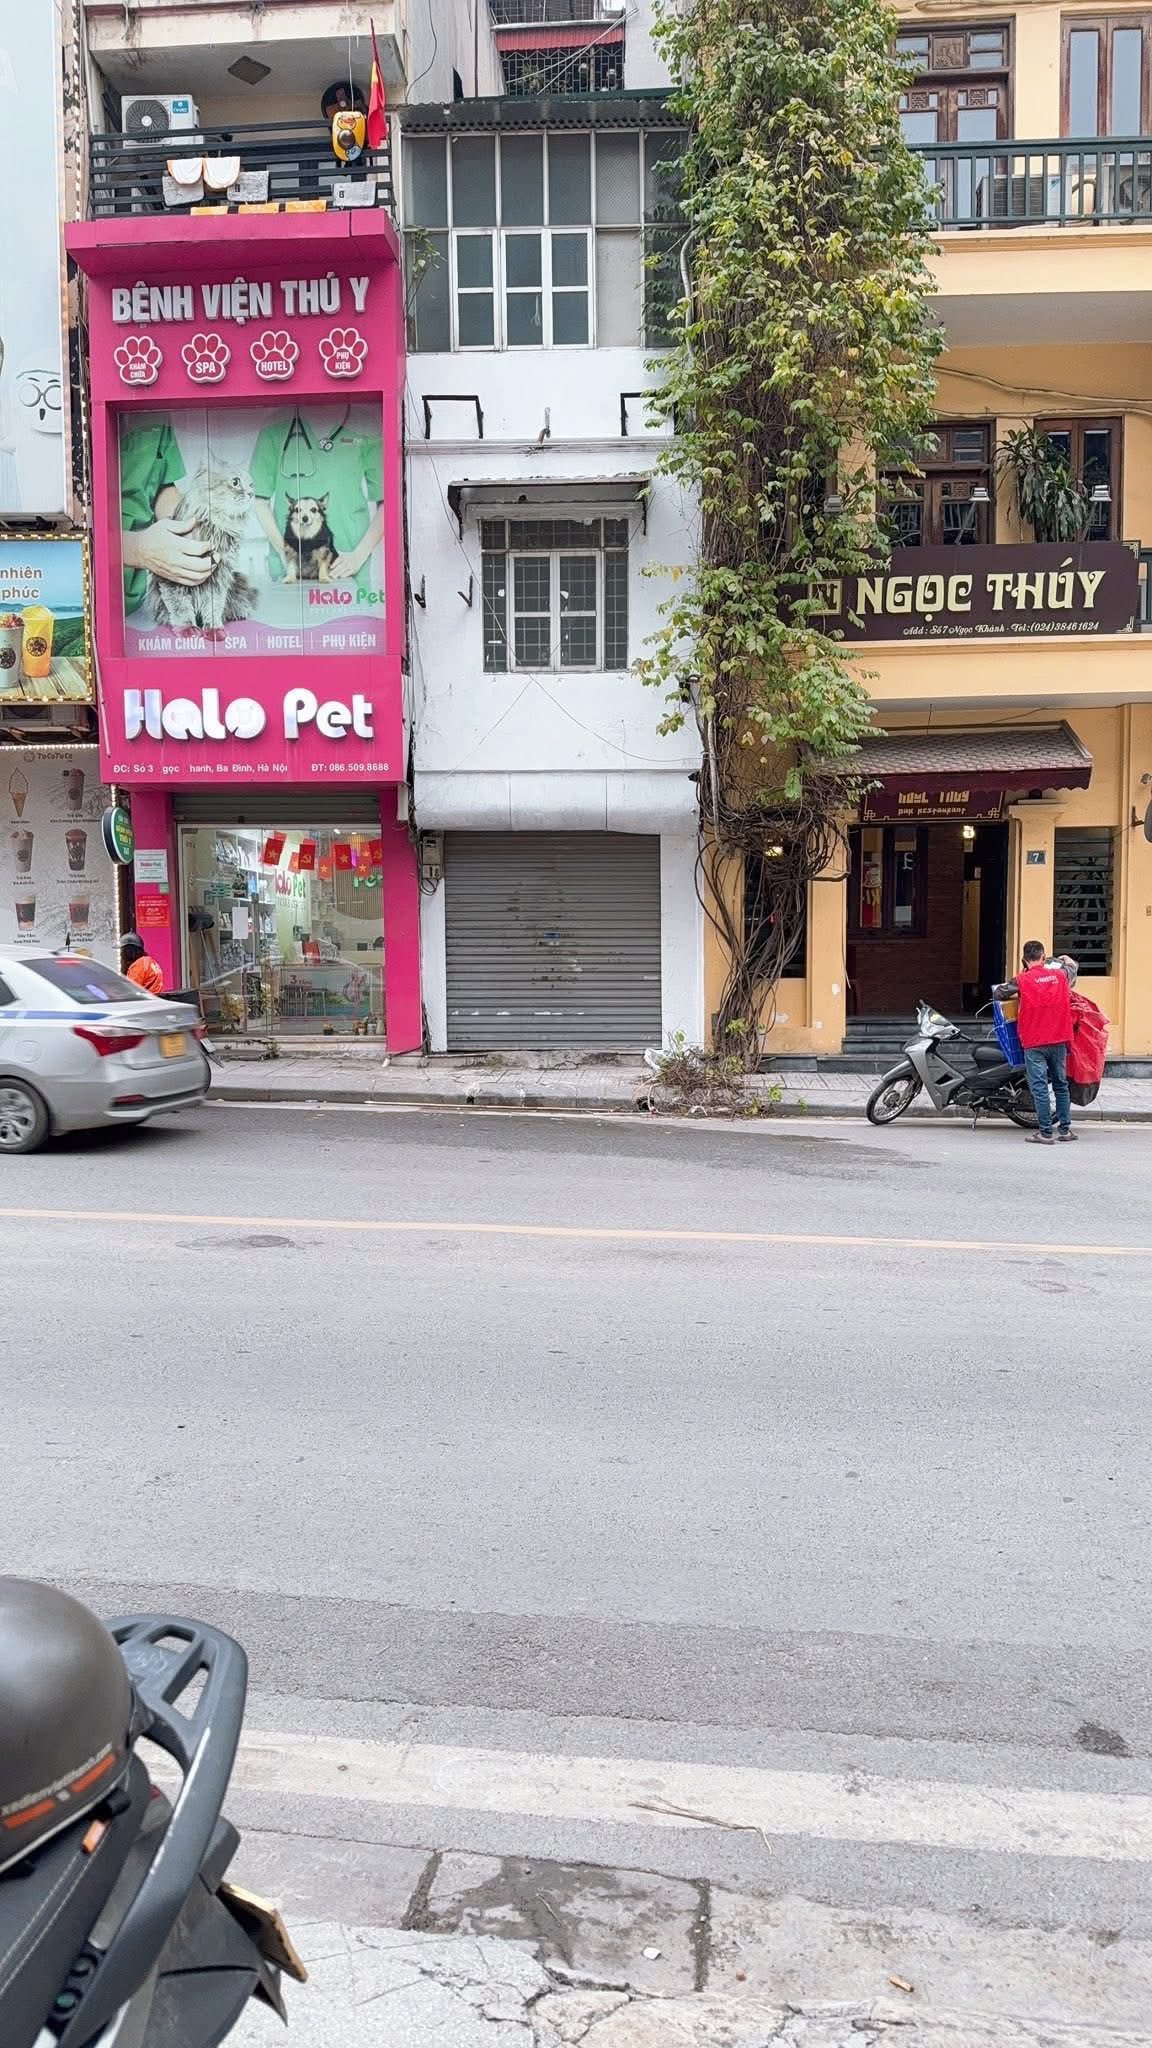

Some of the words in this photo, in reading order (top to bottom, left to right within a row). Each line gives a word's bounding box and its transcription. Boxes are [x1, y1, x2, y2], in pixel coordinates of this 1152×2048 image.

[112, 281, 194, 328] BỆNH
[202, 276, 272, 325] VIỆN
[281, 272, 341, 316] THÚ
[350, 276, 370, 313] Y
[336, 352, 350, 361] PHỤ
[129, 361, 146, 370] KHÁM
[196, 361, 216, 374] SPA
[261, 361, 288, 372] HOTEL
[335, 361, 351, 371] KIỆN
[0, 566, 42, 579] nhiên
[2, 585, 39, 601] phúc
[309, 588, 352, 605] Halo
[356, 587, 385, 605] Pet
[856, 574, 973, 622] NGỌC
[986, 557, 1106, 611] THÚY
[138, 635, 172, 651] KHÁM
[174, 634, 206, 650] CHỮA
[224, 636, 247, 650] SPA
[267, 635, 302, 649] HOTEL
[322, 634, 346, 650] PHỤ
[349, 631, 376, 650] KIỆN
[123, 687, 266, 741] Halo
[283, 687, 375, 741] Pet
[113, 764, 130, 773] ĐC:
[147, 764, 154, 773] 3
[216, 764, 229, 773] Ba
[257, 763, 268, 772] Hà
[311, 763, 327, 772] ĐT:
[329, 763, 389, 772] 086.509.8688
[1033, 852, 1040, 862] 7
